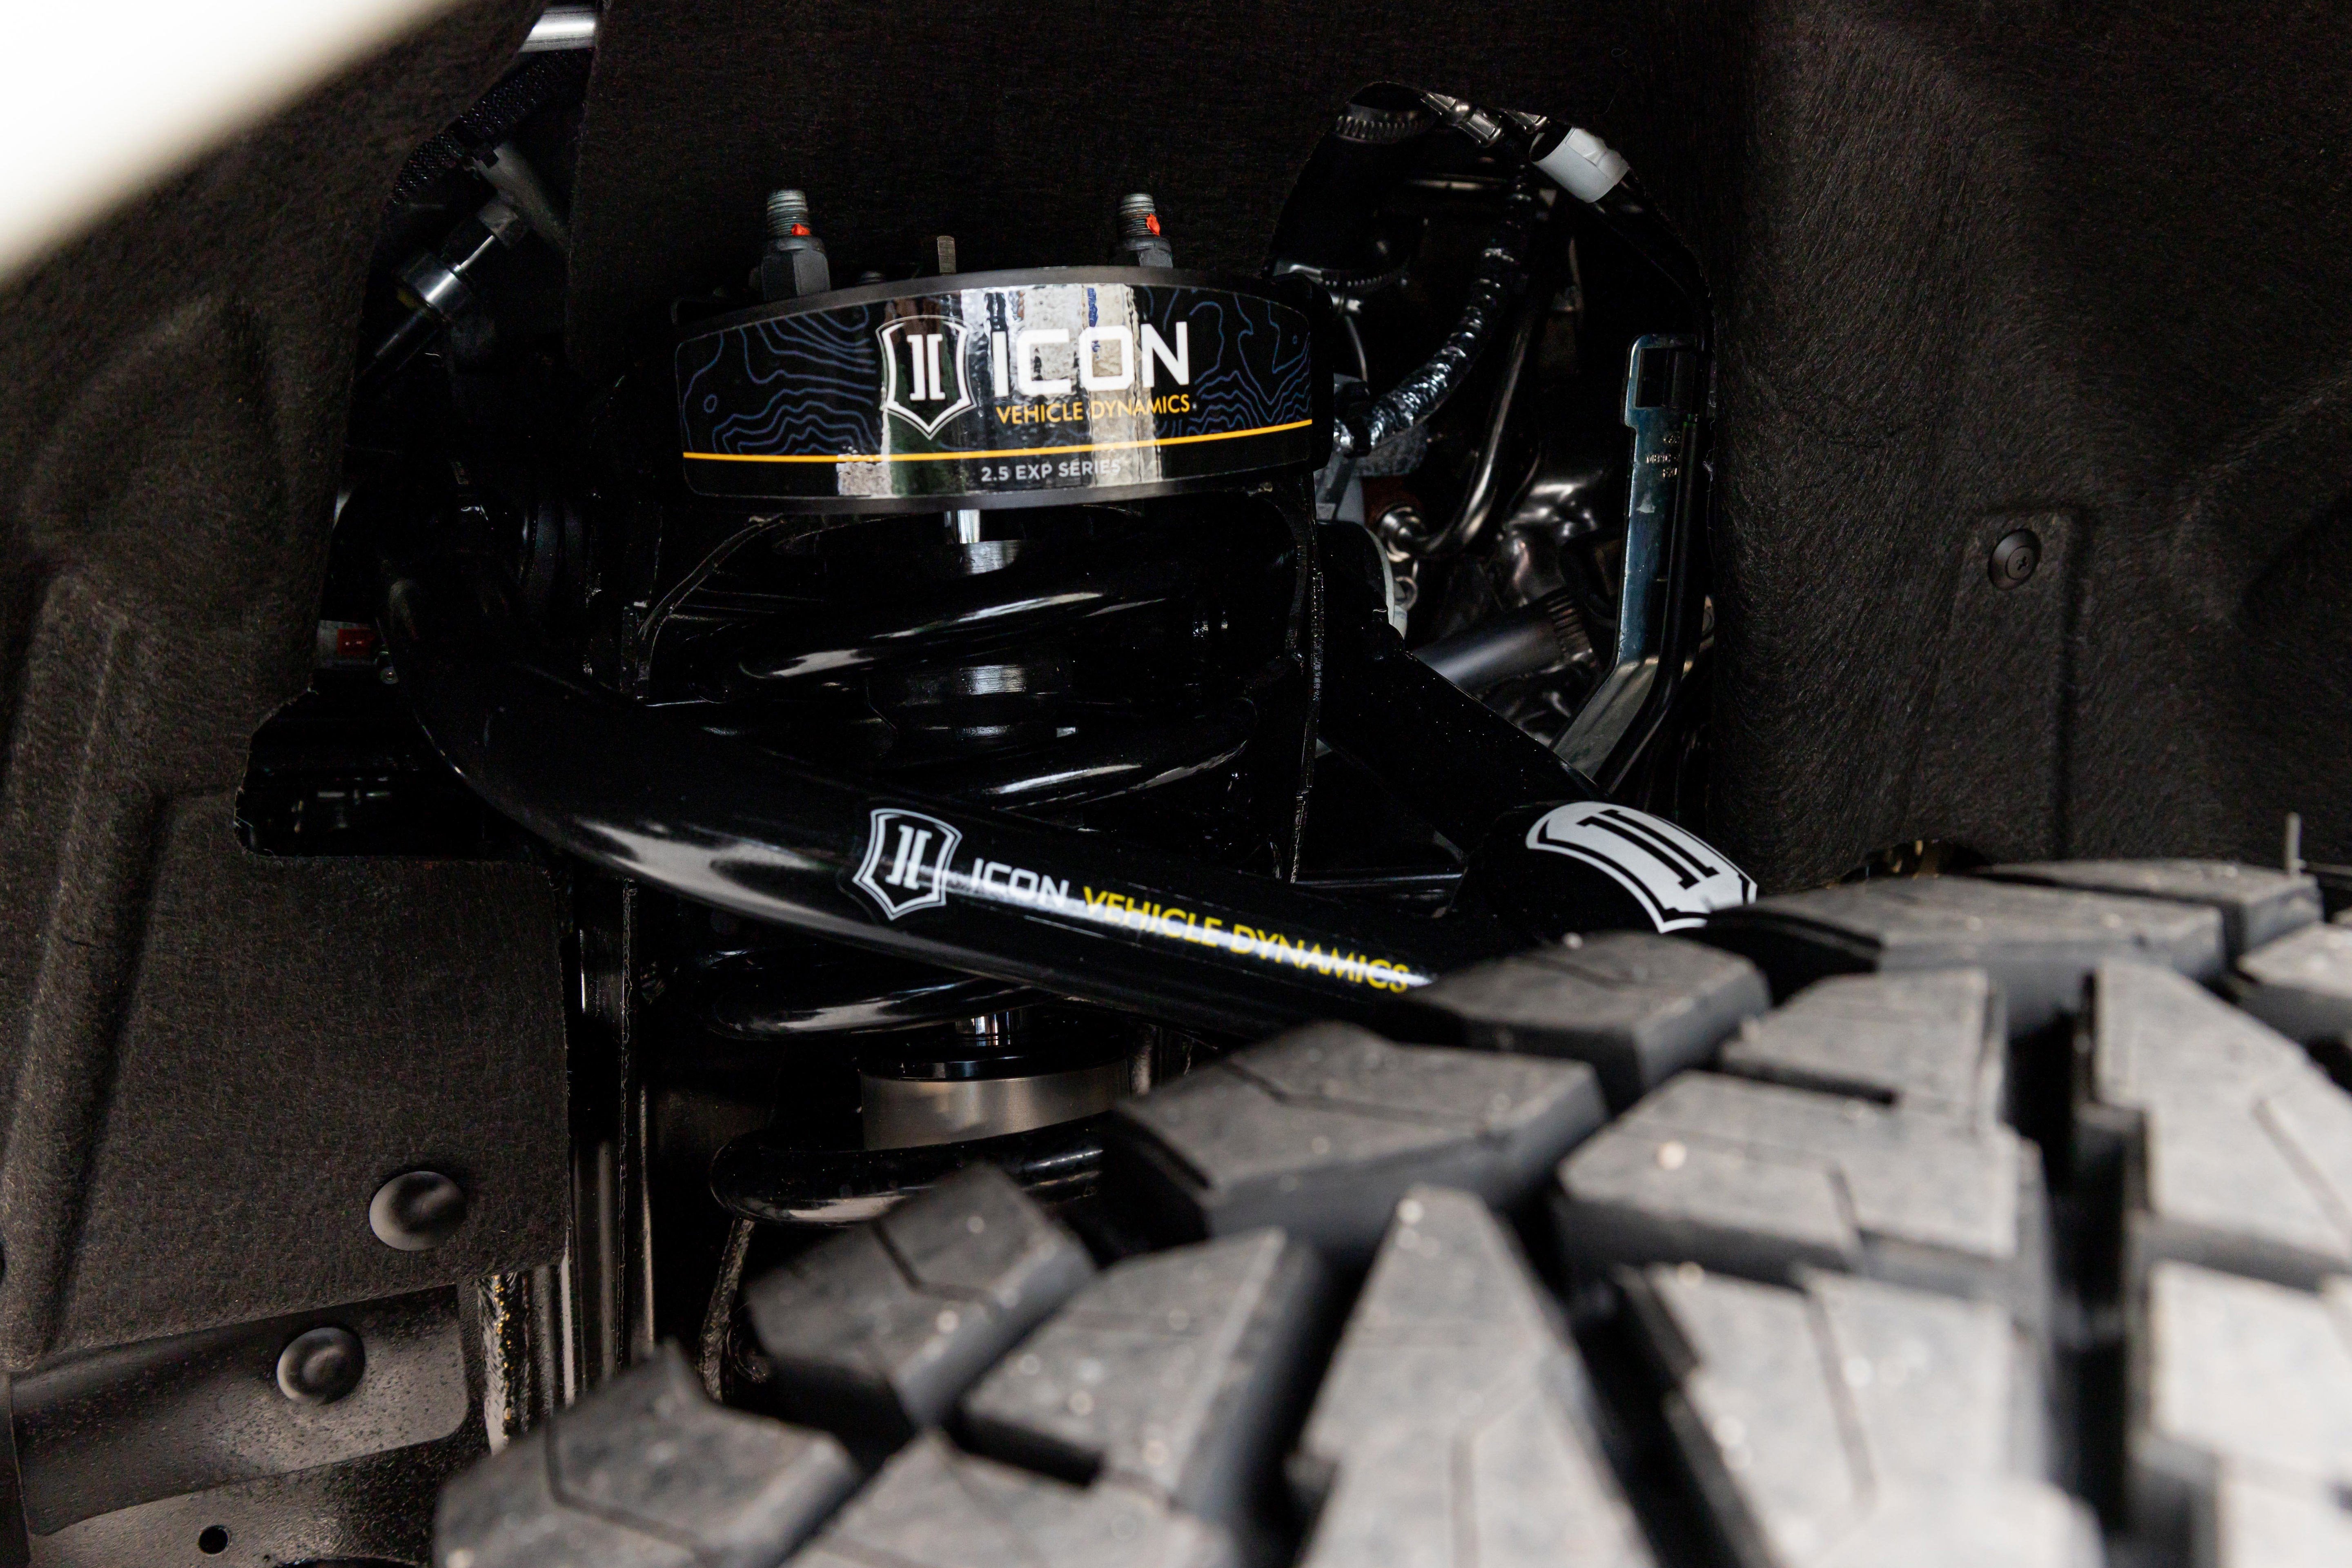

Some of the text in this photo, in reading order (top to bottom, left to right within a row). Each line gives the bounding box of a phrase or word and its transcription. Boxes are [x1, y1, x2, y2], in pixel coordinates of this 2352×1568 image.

[991, 321, 1190, 399] ICON
[996, 394, 1191, 425] VEHICLE DYNAMICS
[981, 458, 1121, 482] 2.5 EXP SERIES
[969, 857, 1411, 994] ICON VEHICLE DYNAMICS
